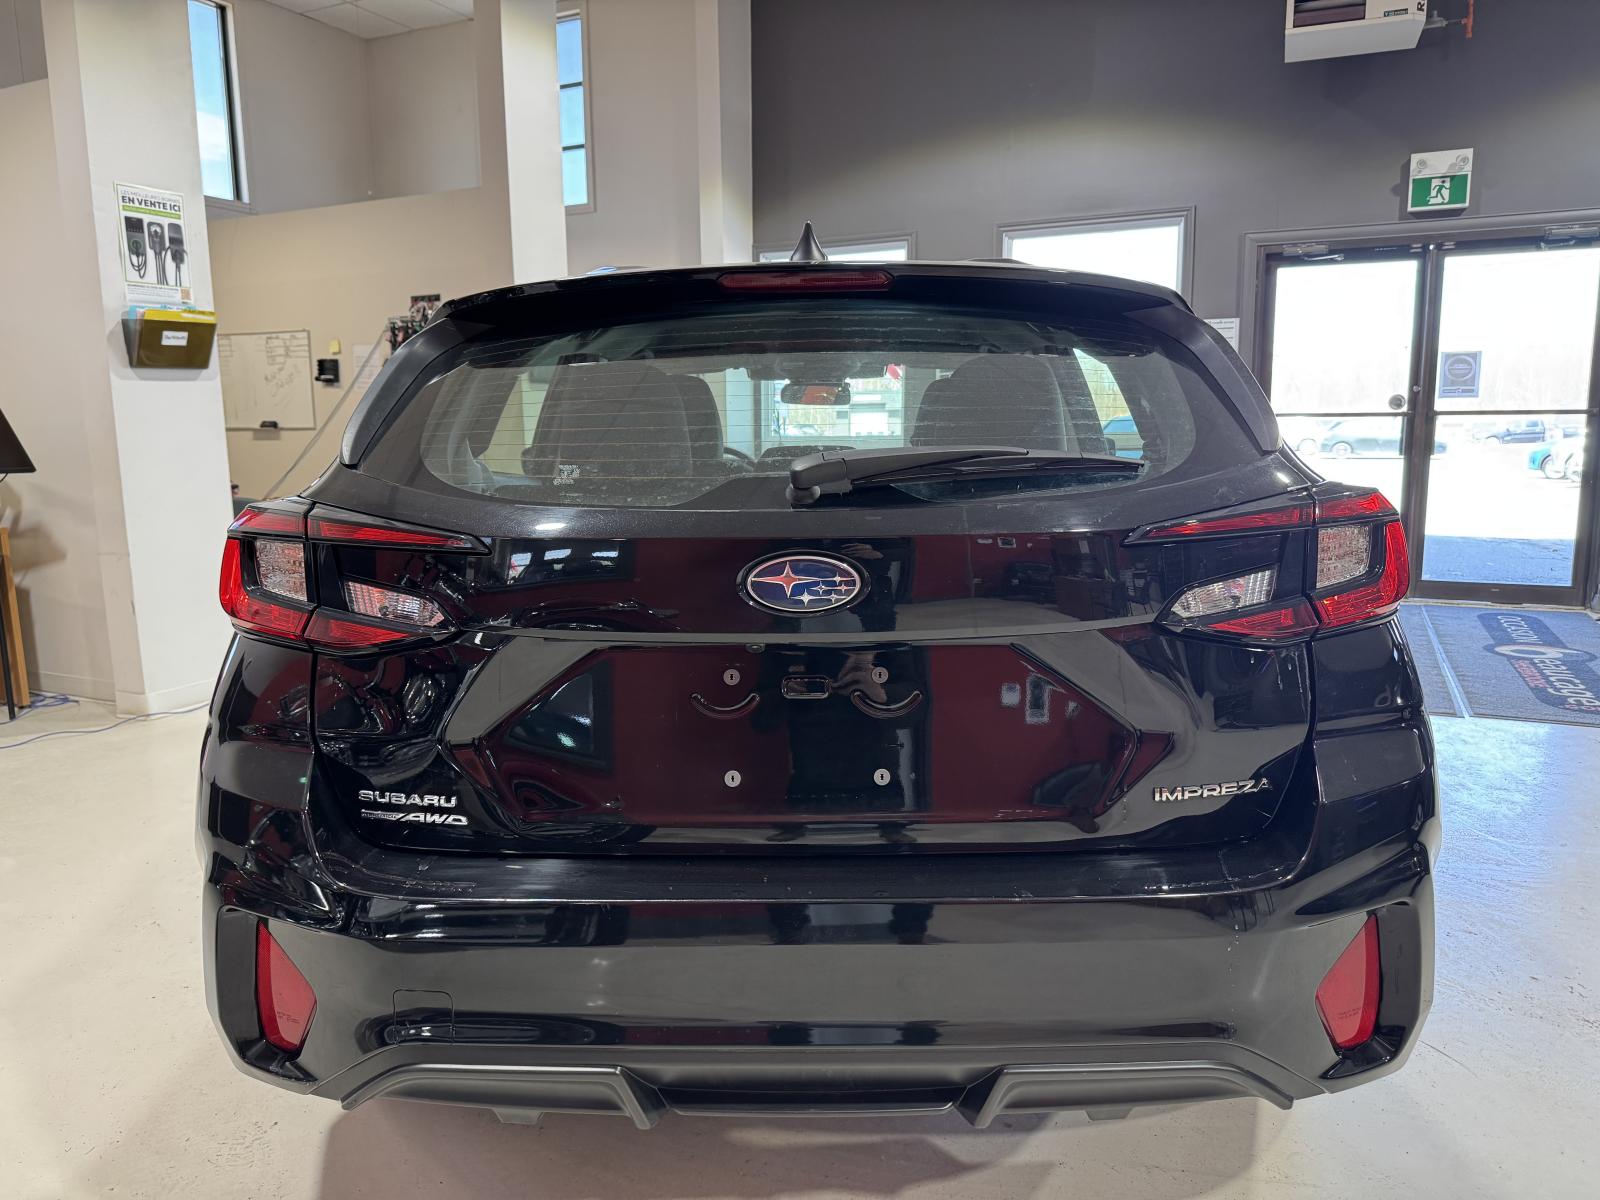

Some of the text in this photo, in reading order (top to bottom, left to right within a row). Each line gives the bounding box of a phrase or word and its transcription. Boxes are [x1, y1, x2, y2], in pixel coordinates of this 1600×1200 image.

[121, 195, 135, 205] EN
[136, 198, 168, 210] VENTE
[169, 203, 181, 212] ICI
[1154, 778, 1272, 802] IMPREZA
[358, 790, 457, 808] SUBARU
[400, 812, 469, 825] AWD
